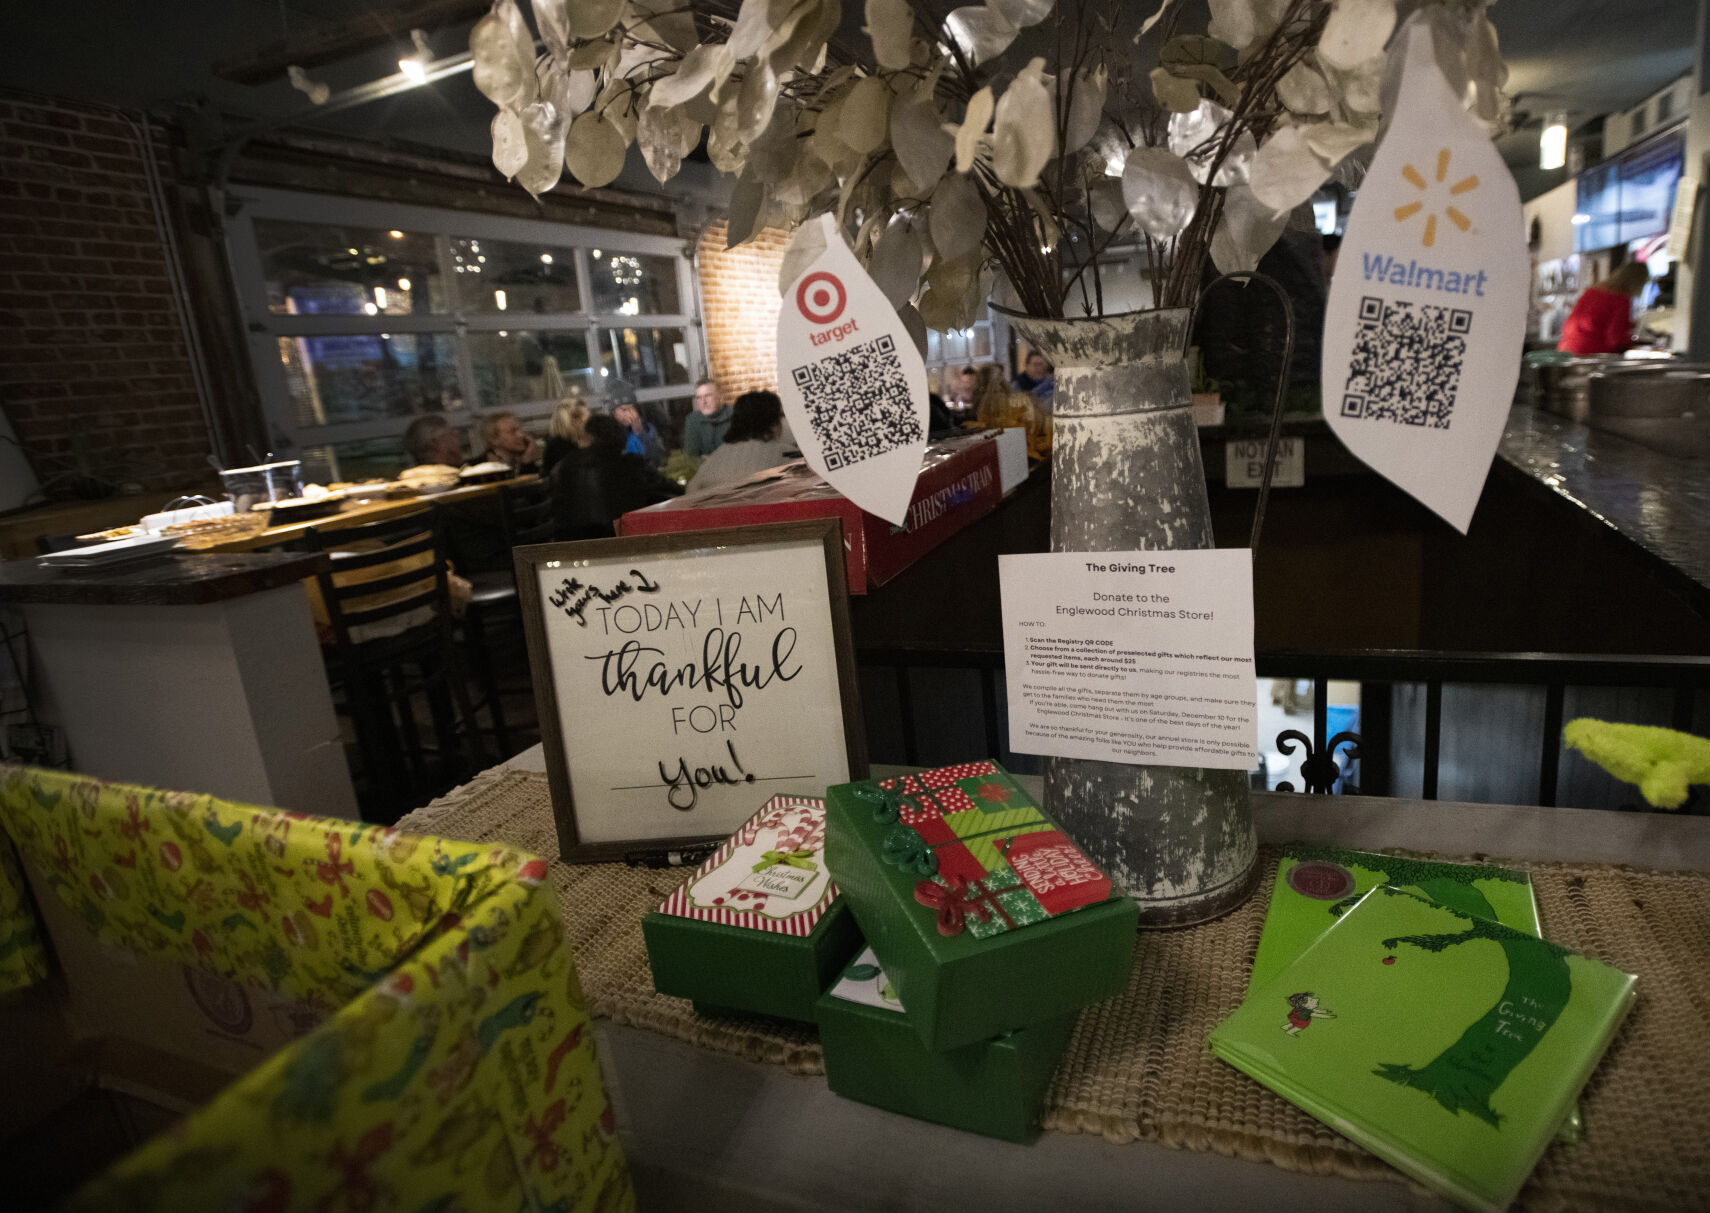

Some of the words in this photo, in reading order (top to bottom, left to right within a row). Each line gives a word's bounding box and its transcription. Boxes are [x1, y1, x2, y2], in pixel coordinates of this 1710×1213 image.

[1363, 252, 1487, 296] Walmart
[809, 317, 859, 346] target
[1086, 562, 1106, 572] The
[1109, 562, 1146, 575] Giving
[1148, 564, 1176, 573] Tree
[597, 580, 632, 605] here
[1093, 592, 1133, 602] Donate
[1136, 594, 1148, 602] to
[1150, 594, 1170, 603] the
[596, 599, 702, 635] TODAY
[716, 597, 723, 626] I
[736, 592, 785, 625] AM
[1056, 605, 1115, 616] Englewood
[1118, 608, 1176, 619] Christmas
[1178, 609, 1214, 621] Store!
[1058, 638, 1084, 646] Registry
[584, 627, 803, 709] thankful
[1094, 664, 1119, 672] directly
[1176, 670, 1208, 678] registries
[1037, 708, 1069, 716] Englewood
[1088, 704, 1103, 712] hang
[1150, 710, 1181, 718] Saturday,
[1182, 712, 1216, 720] December
[1240, 700, 1256, 708] they
[672, 704, 737, 735] FOR
[1059, 725, 1084, 733] thankful
[1109, 732, 1144, 741] generosity,
[1221, 741, 1250, 749] possible
[1070, 735, 1095, 743] amazing
[1152, 742, 1167, 750] help
[1168, 744, 1193, 752] provide
[1194, 746, 1229, 755] affordable
[765, 866, 805, 883] hristmas
[1012, 854, 1055, 894] SENDING
[1039, 848, 1088, 886] HOLIDAY
[1498, 1001, 1547, 1031] Giving
